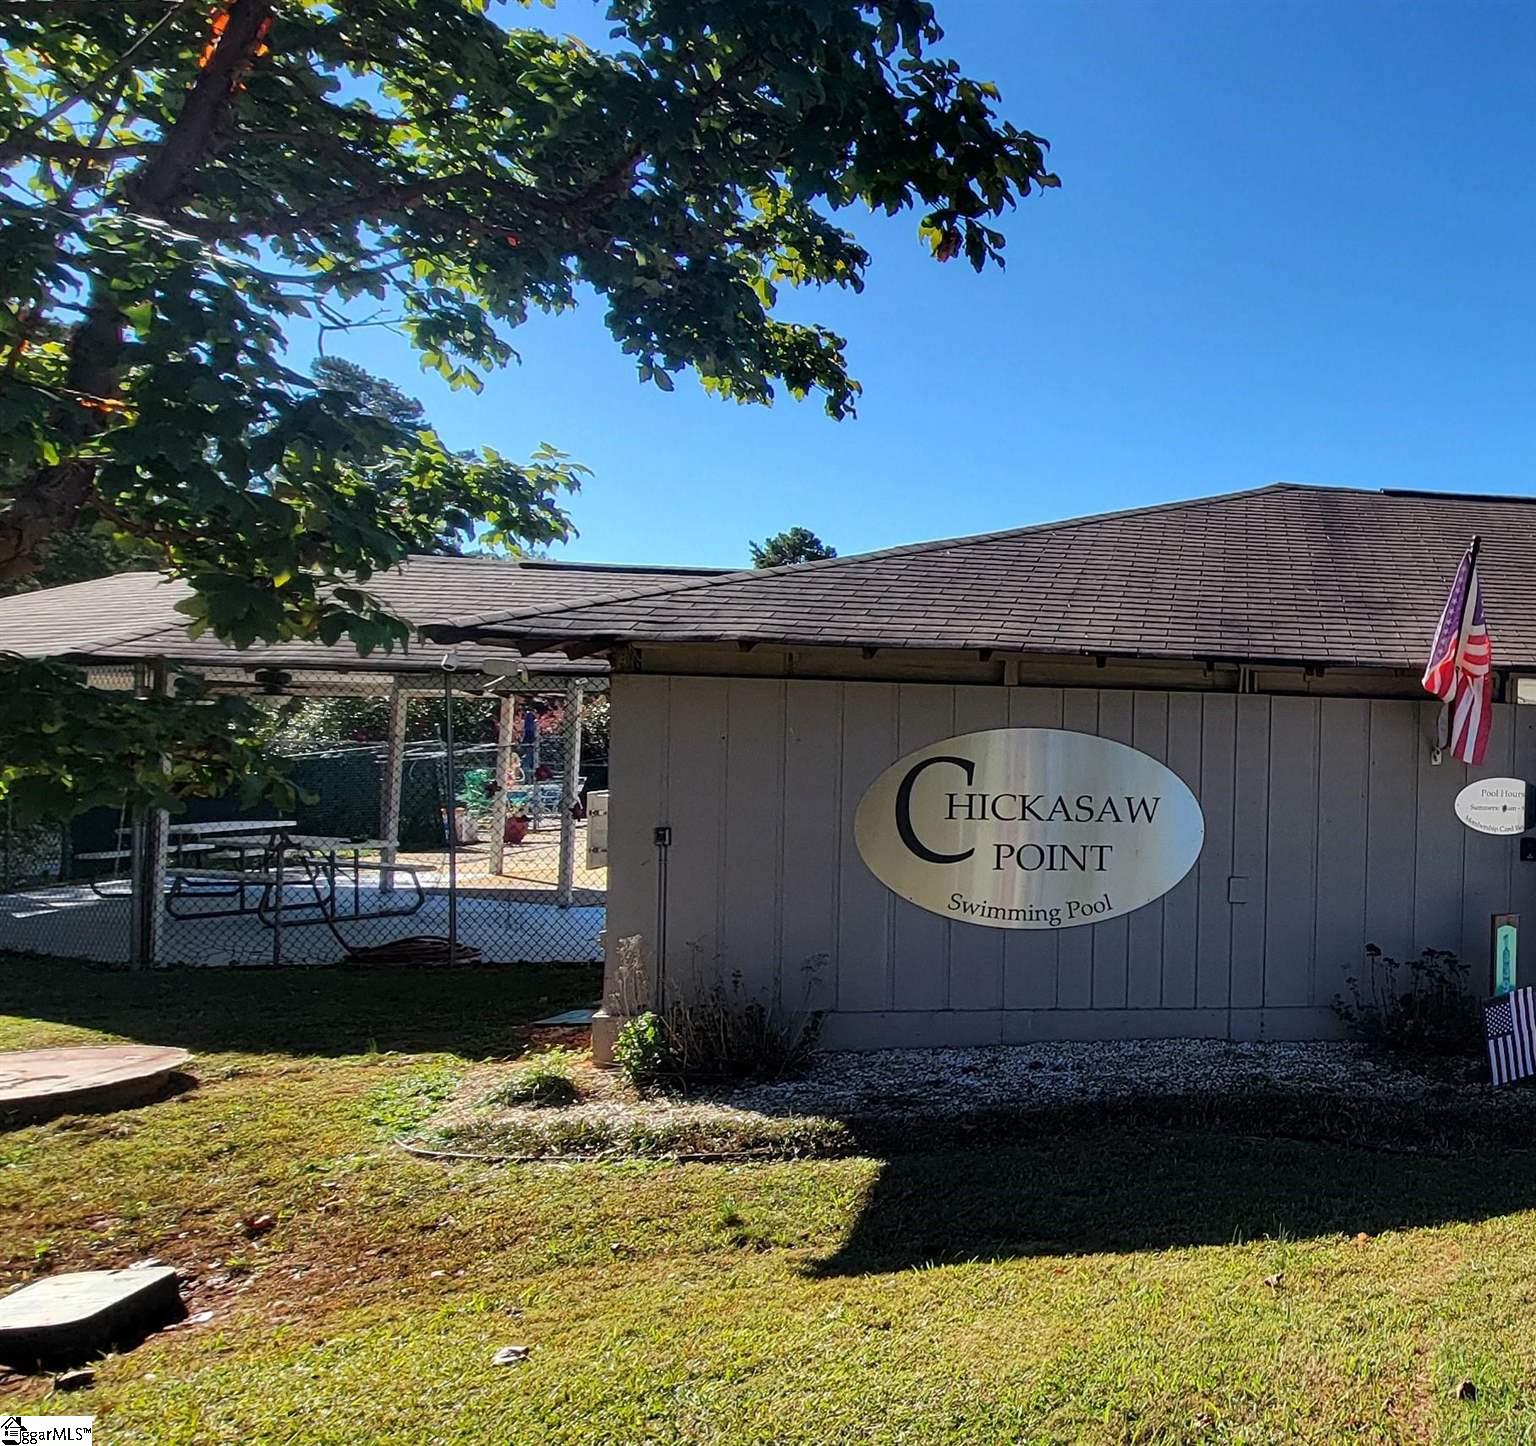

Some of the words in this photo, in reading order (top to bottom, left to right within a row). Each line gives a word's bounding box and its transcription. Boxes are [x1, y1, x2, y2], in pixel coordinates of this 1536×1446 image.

[1481, 789, 1498, 798] Pool
[895, 756, 1161, 864] CHICKASAW
[992, 843, 1113, 872] POINT
[947, 893, 1062, 926] Swimming
[1066, 894, 1113, 920] Pool
